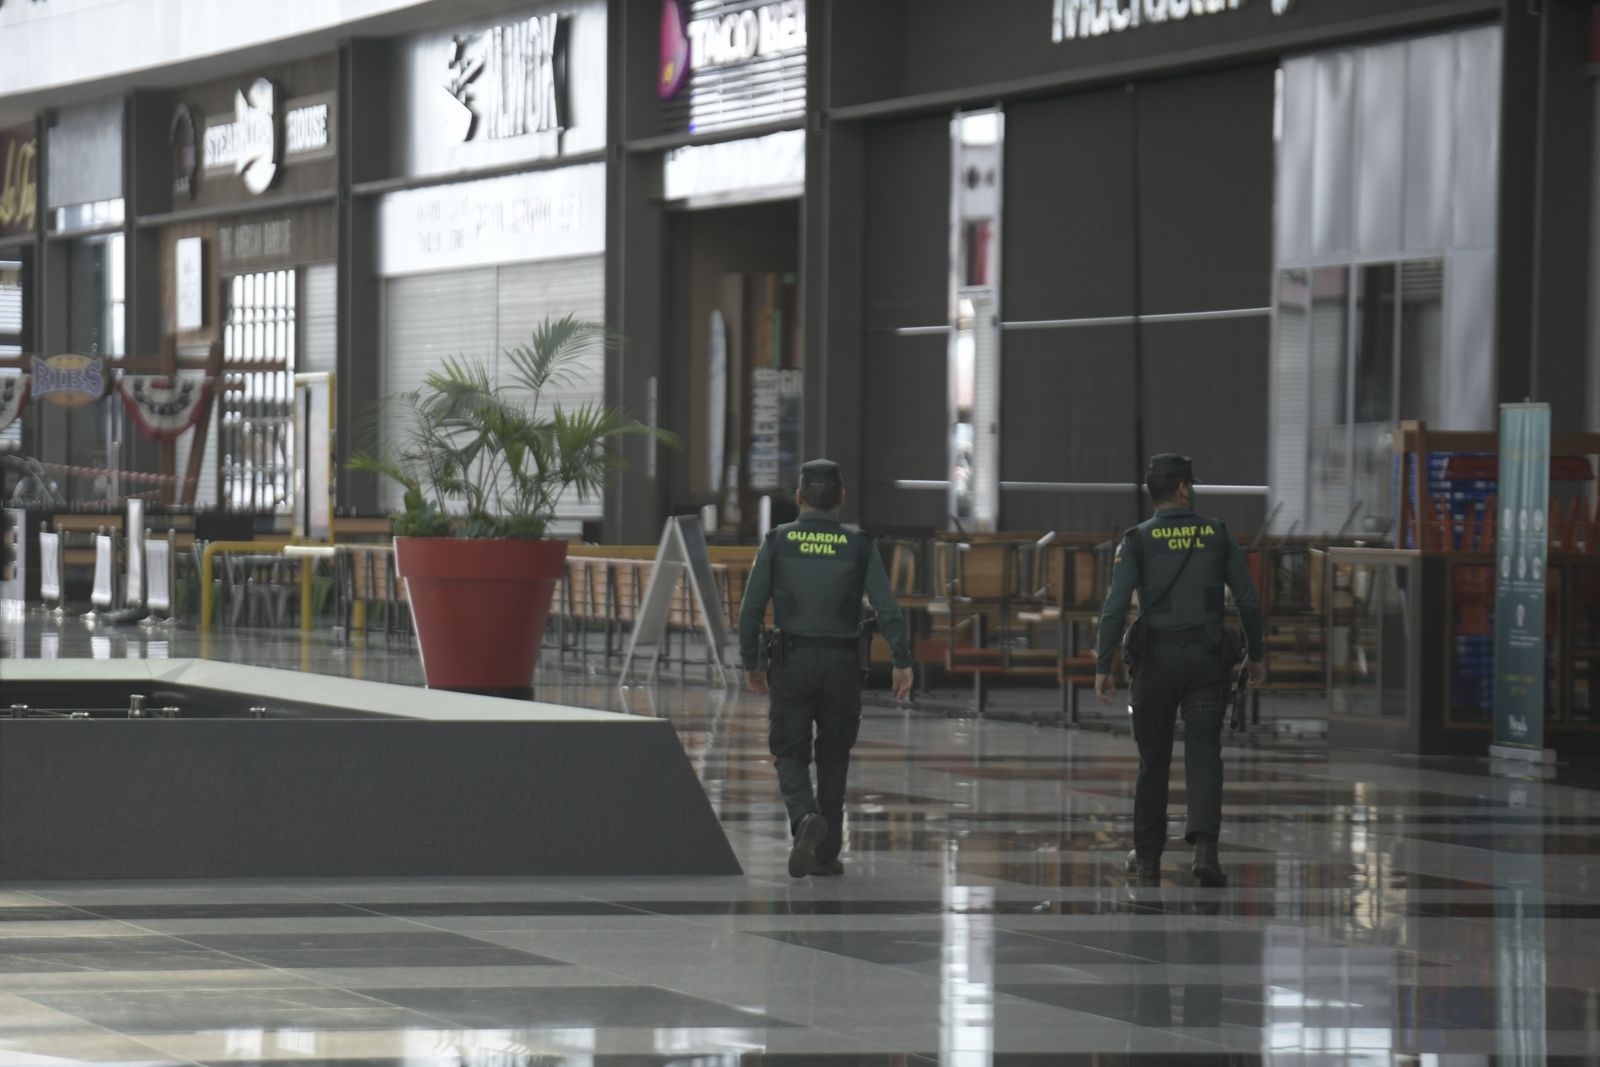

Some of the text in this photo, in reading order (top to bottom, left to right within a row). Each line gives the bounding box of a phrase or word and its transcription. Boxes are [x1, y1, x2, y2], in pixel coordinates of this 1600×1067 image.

[687, 8, 758, 67] TACO
[286, 104, 328, 153] HOUSE
[32, 355, 105, 399] RIBS
[787, 530, 848, 544] GUARDIA
[800, 542, 836, 554] CIVIL
[1168, 537, 1205, 549] CIVL
